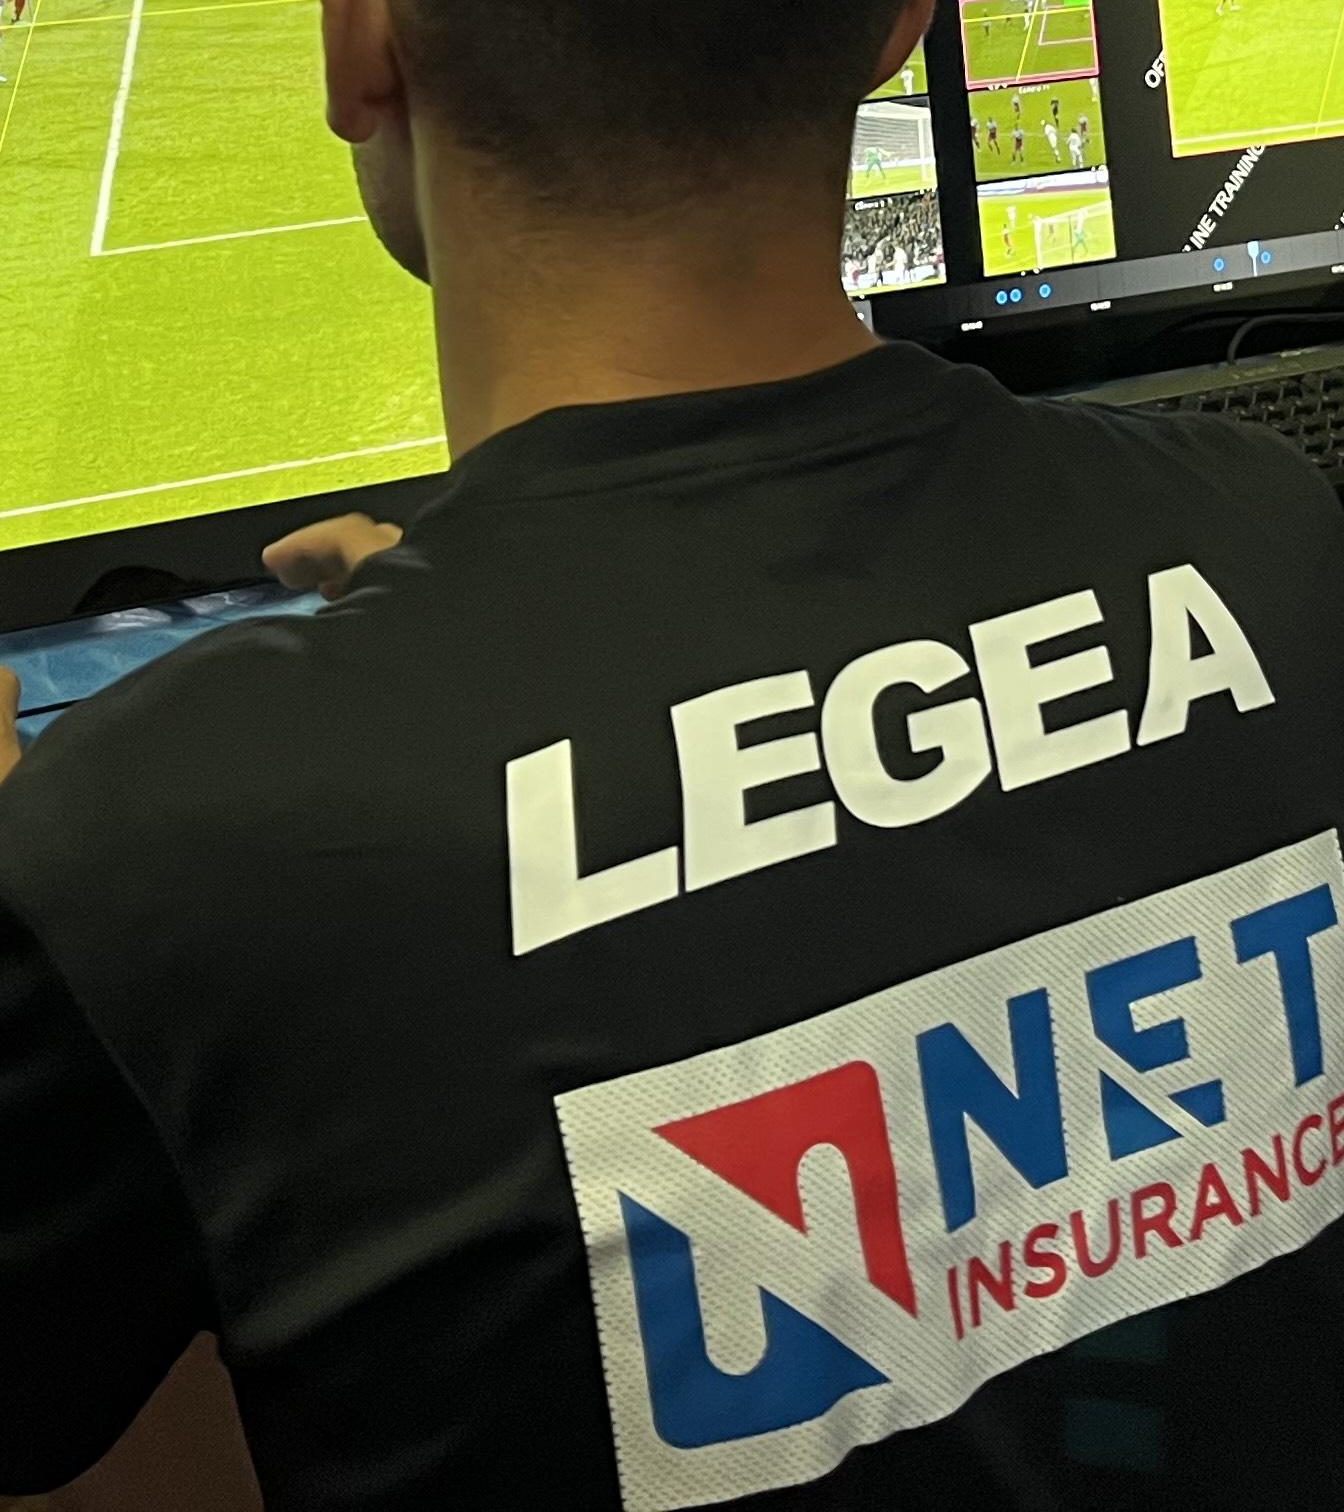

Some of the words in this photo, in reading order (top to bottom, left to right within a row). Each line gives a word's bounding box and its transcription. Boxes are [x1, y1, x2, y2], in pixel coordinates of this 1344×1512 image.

[1182, 214, 1216, 251] INE
[505, 563, 1276, 958] LEGEA
[916, 882, 1340, 1234] NET
